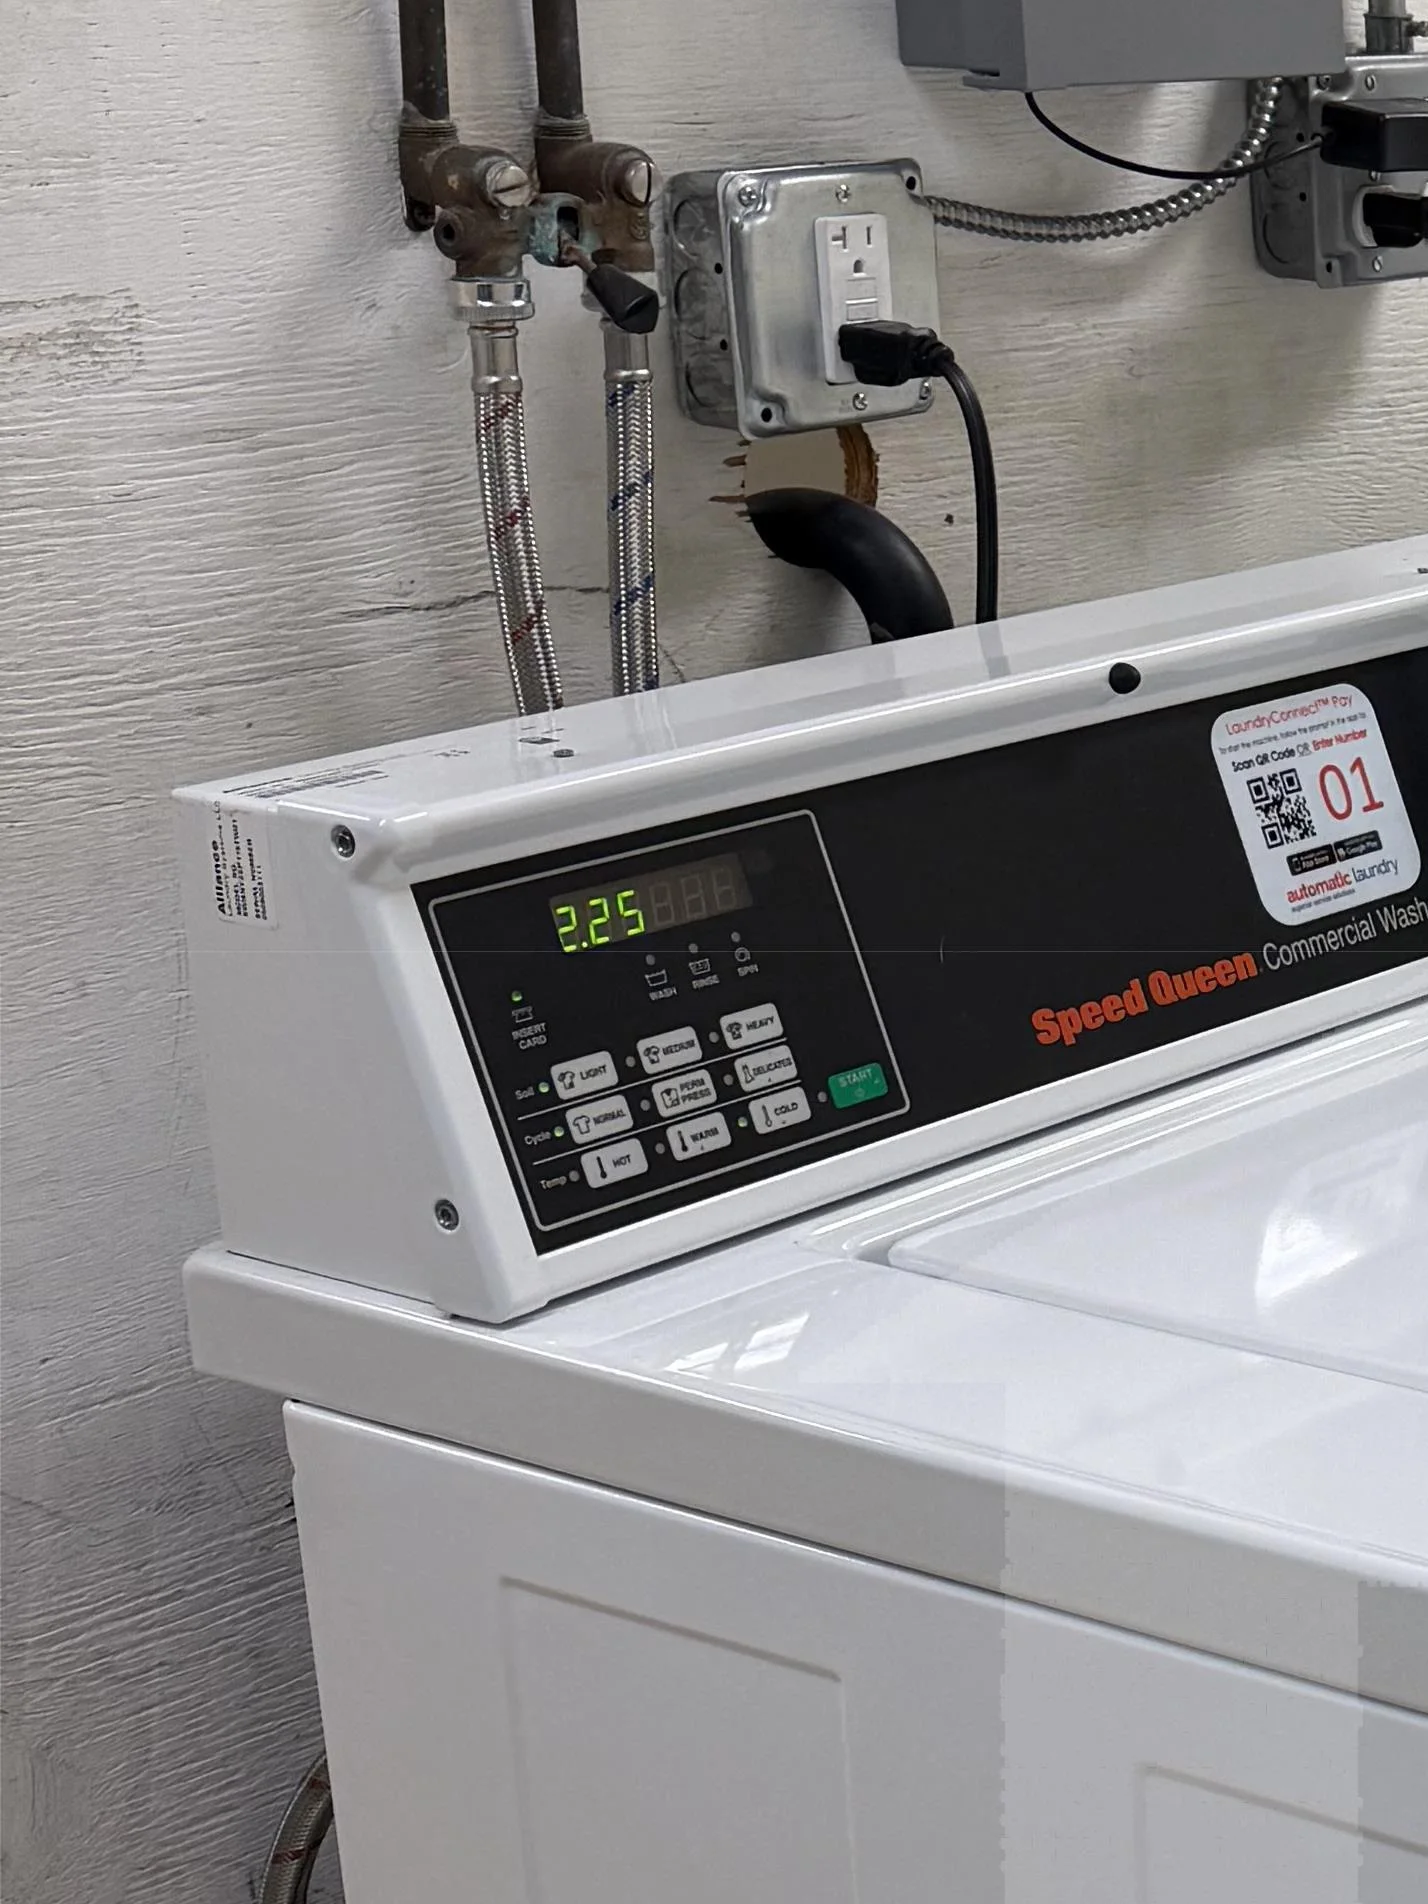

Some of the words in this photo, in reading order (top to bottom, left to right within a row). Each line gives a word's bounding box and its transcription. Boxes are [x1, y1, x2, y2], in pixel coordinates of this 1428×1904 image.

[1231, 758, 1256, 773] Scan
[1255, 752, 1271, 766] QR
[1270, 747, 1297, 763] Code
[1312, 737, 1335, 752] Enter
[1334, 728, 1368, 745] Number
[1318, 756, 1385, 823] 01
[1286, 869, 1353, 904] automatic
[1352, 857, 1400, 884] laundry
[555, 890, 645, 954] 2.25
[1030, 977, 1149, 1047] Speed
[1147, 951, 1259, 1008] Queen
[1262, 911, 1377, 972] Commercial
[511, 1022, 547, 1041] INSERT
[745, 1015, 775, 1032] HEAVY
[518, 1035, 548, 1050] CARD
[579, 1064, 608, 1081] LIGHT
[838, 1067, 874, 1089] START
[515, 1086, 536, 1100] Soil
[679, 1077, 706, 1093] PERM
[680, 1088, 713, 1105] PRESS
[774, 1101, 800, 1117] COLD
[524, 1130, 552, 1146] Cycle
[690, 1126, 720, 1143] WARM
[612, 1153, 633, 1169] HOT
[540, 1175, 568, 1190] Temp
